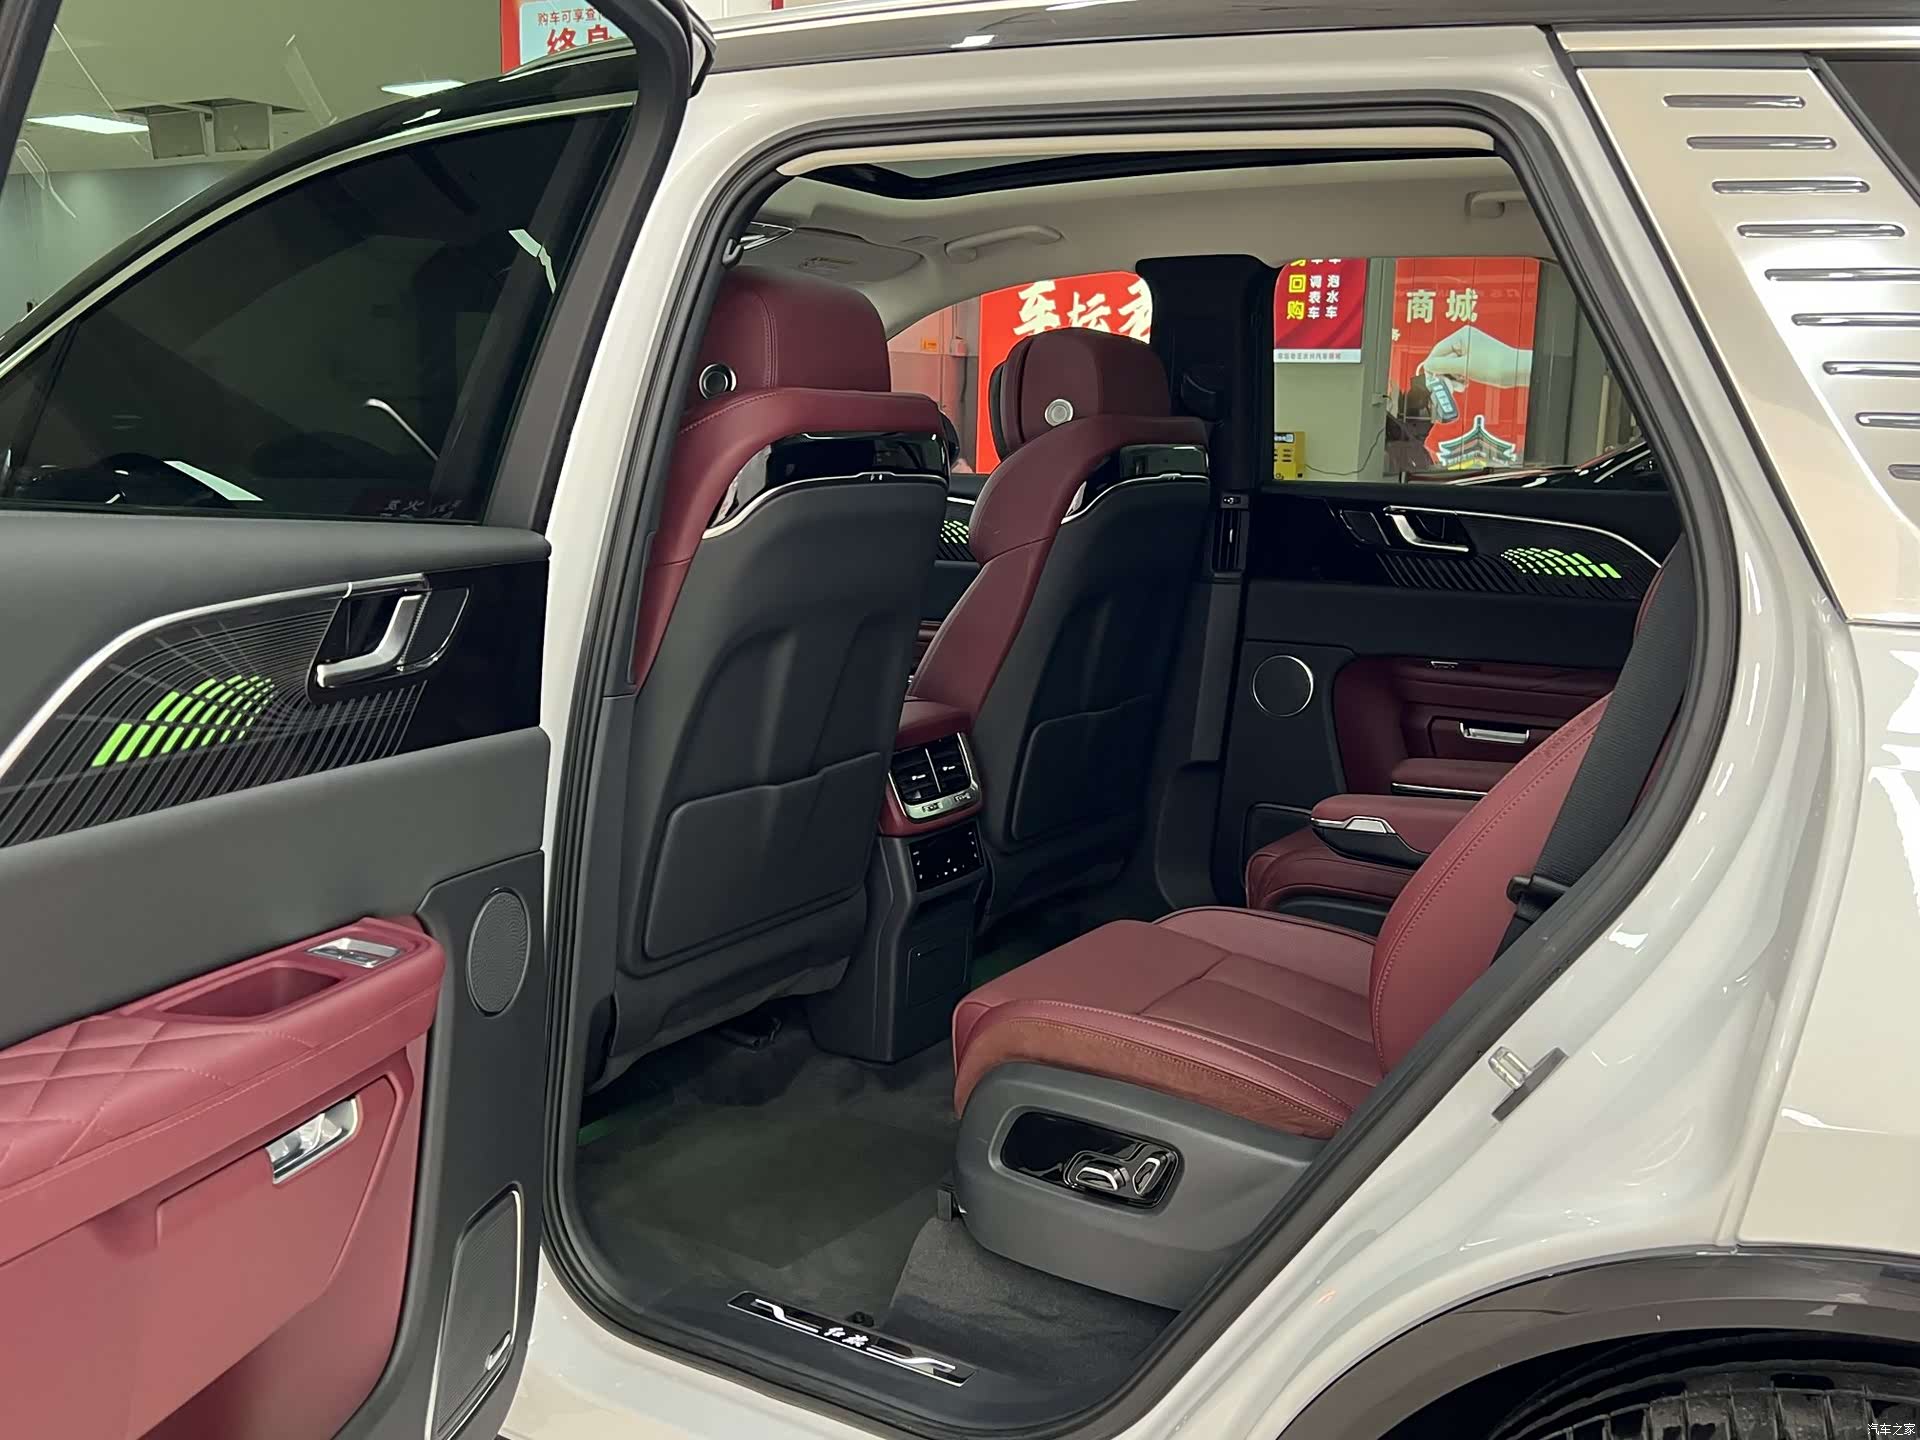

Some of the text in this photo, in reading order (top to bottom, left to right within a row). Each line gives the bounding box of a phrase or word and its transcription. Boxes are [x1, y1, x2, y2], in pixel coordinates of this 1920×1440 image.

[537, 8, 601, 25] 购车可享查
[1325, 274, 1341, 319] 泡水车
[1406, 288, 1478, 323] 商城
